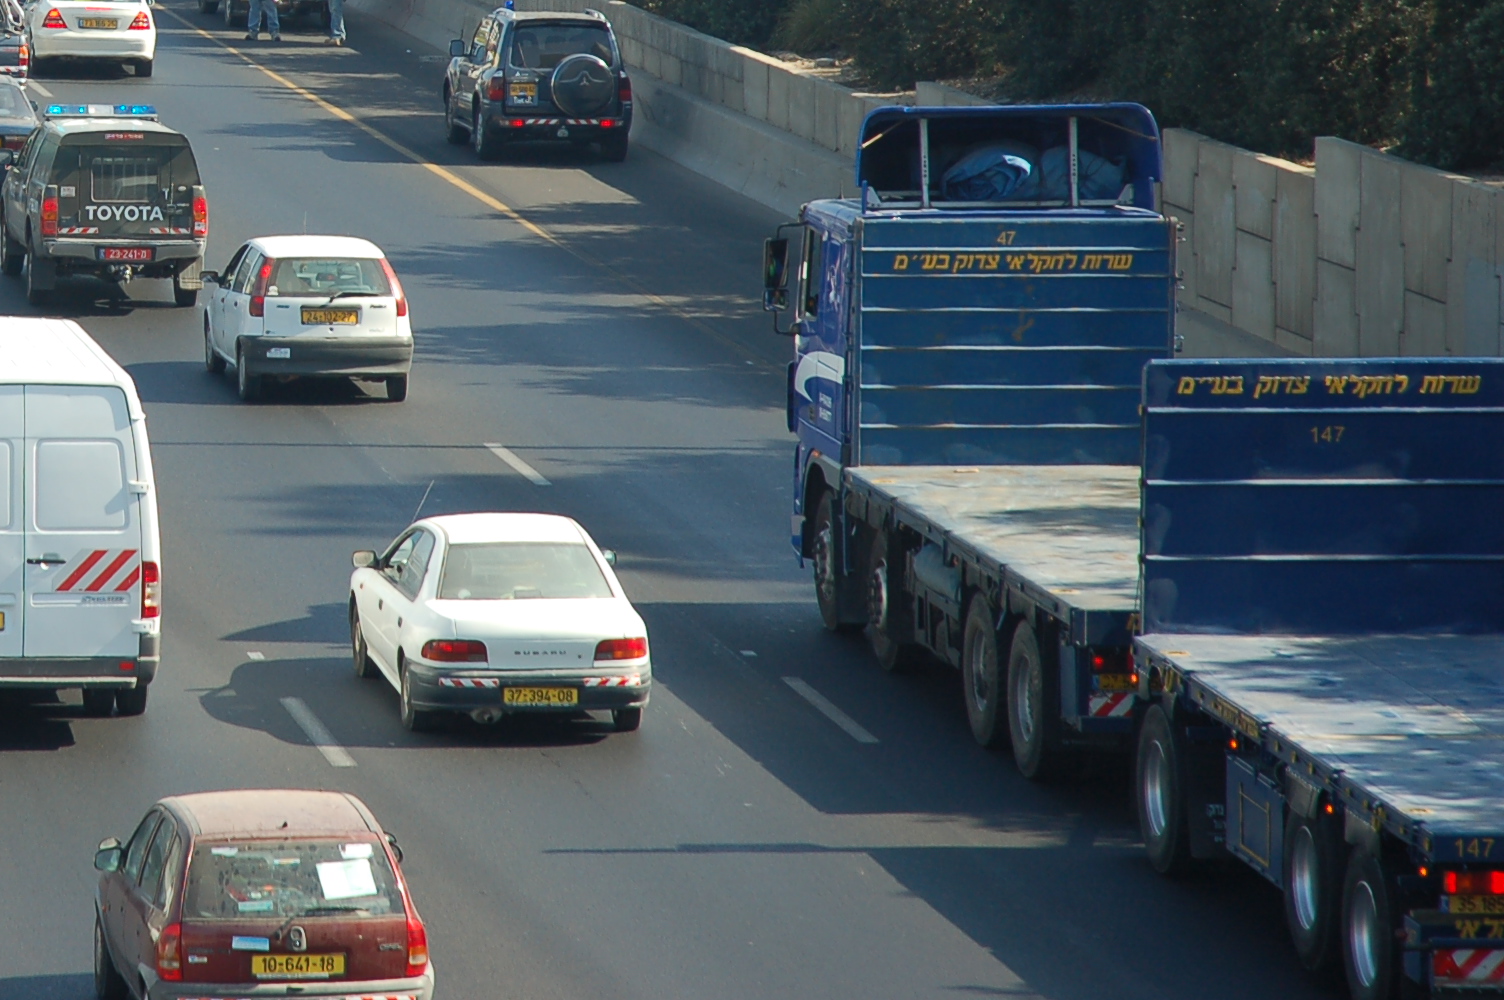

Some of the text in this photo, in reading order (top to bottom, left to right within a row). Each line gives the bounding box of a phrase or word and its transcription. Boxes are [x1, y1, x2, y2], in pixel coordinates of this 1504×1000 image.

[85, 205, 164, 221] TOYOTA
[997, 230, 1017, 245] 47
[1005, 252, 1078, 274] לחקלאי
[1080, 253, 1133, 270] שרות
[1324, 373, 1410, 398] לחקלאי
[1419, 375, 1481, 395] שרות
[1310, 426, 1345, 443] 147
[506, 688, 574, 703] 37-394-08
[1454, 837, 1495, 858] 147
[261, 956, 336, 973] 10-641-18
